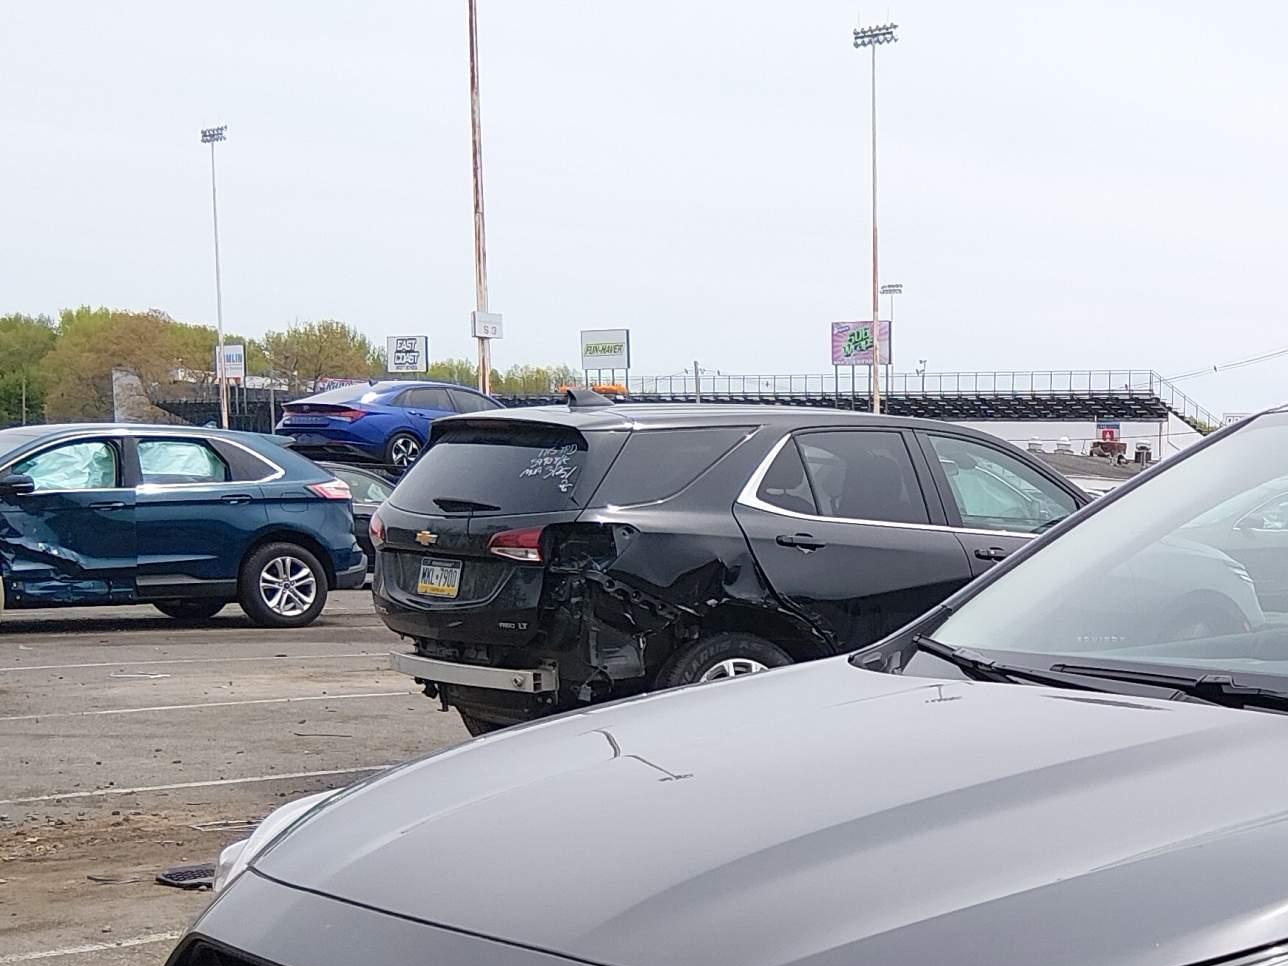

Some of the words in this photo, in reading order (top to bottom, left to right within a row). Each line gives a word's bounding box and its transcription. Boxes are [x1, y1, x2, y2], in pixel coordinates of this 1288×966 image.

[396, 338, 417, 351] EAST
[394, 351, 420, 365] COAST
[518, 622, 529, 630] LT
